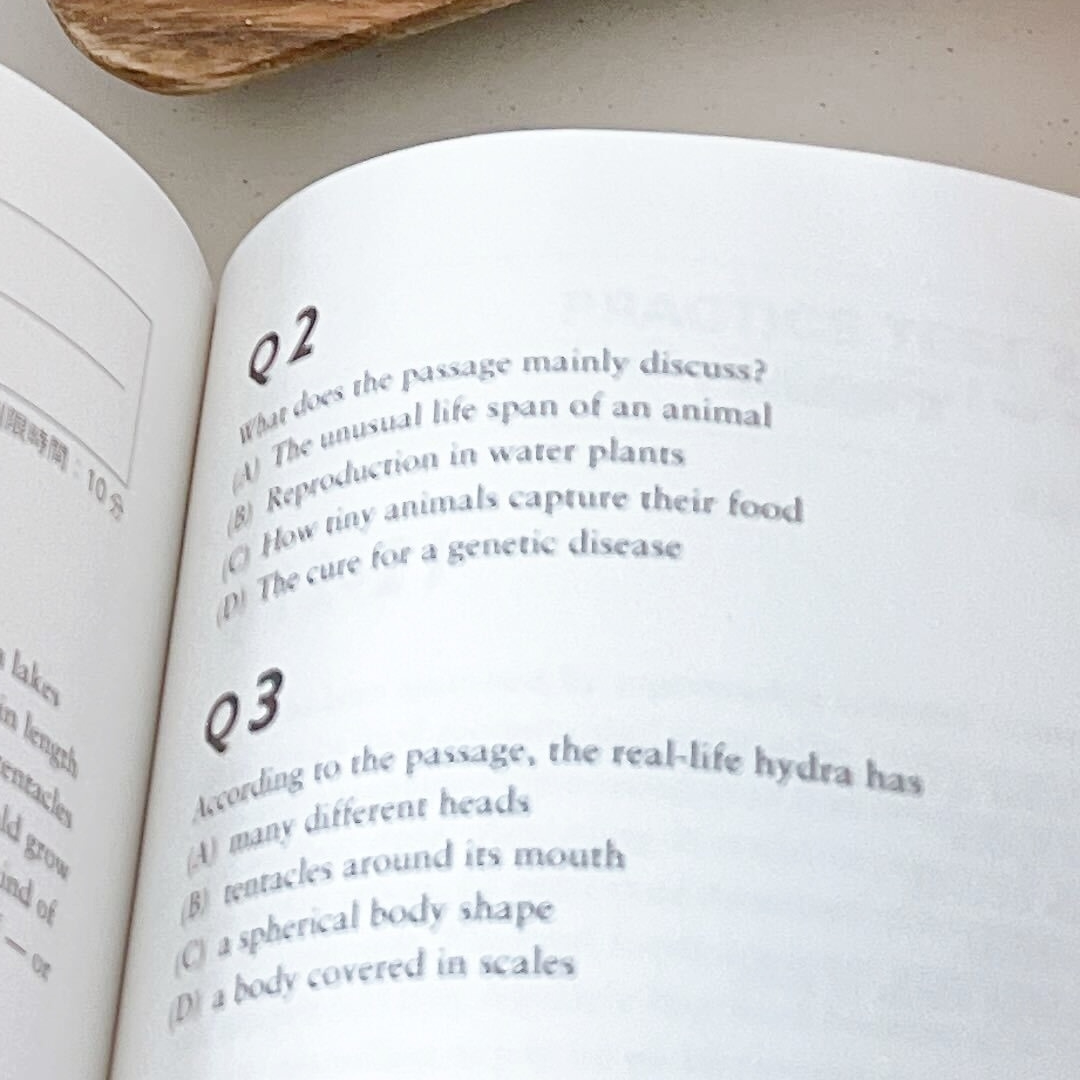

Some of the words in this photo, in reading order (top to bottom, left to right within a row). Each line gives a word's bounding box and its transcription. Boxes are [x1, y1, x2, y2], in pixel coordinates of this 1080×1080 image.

[238, 406, 289, 444] What
[293, 385, 345, 418] does
[353, 369, 395, 398] the
[402, 357, 512, 393] passage
[523, 347, 630, 380] mainly
[640, 350, 767, 383] discuss?
[272, 435, 314, 468] The
[320, 401, 424, 451] unusual
[433, 394, 478, 424] life
[486, 397, 559, 426] span
[569, 390, 606, 419] of
[612, 399, 651, 418] an
[662, 397, 772, 429] animal
[267, 449, 440, 515] Reproduction
[450, 441, 478, 466] in
[489, 442, 577, 464] water
[588, 436, 686, 469] plants
[262, 520, 318, 558] How
[325, 503, 376, 536] tiny
[384, 482, 500, 522] animals
[508, 488, 630, 515] capture
[641, 483, 718, 514] their
[728, 488, 804, 524] food
[257, 568, 301, 602] The
[307, 553, 362, 586] cure
[372, 540, 413, 570] for
[421, 543, 439, 562] a
[447, 528, 560, 566] genetic
[568, 527, 684, 560] disease
[192, 765, 305, 822] According
[313, 756, 341, 783] to
[351, 745, 396, 776] the
[405, 742, 536, 776] passage,
[549, 733, 601, 764] the
[612, 737, 744, 775] real-life
[754, 745, 855, 787] hydra
[866, 758, 925, 797] has
[22, 832, 71, 882] grow
[229, 819, 296, 856] many
[304, 796, 429, 835] different
[439, 784, 531, 818] heads
[223, 857, 333, 906] tentacles
[343, 838, 454, 879] around
[464, 839, 501, 867] its
[514, 838, 626, 869] mouth
[217, 935, 231, 959] a
[238, 898, 360, 956] spherical
[370, 892, 448, 933] body
[459, 890, 556, 932] shape
[211, 989, 226, 1011] a
[233, 964, 297, 1006] body
[307, 946, 426, 991] covered
[436, 948, 467, 977] in
[479, 944, 575, 978] scales
